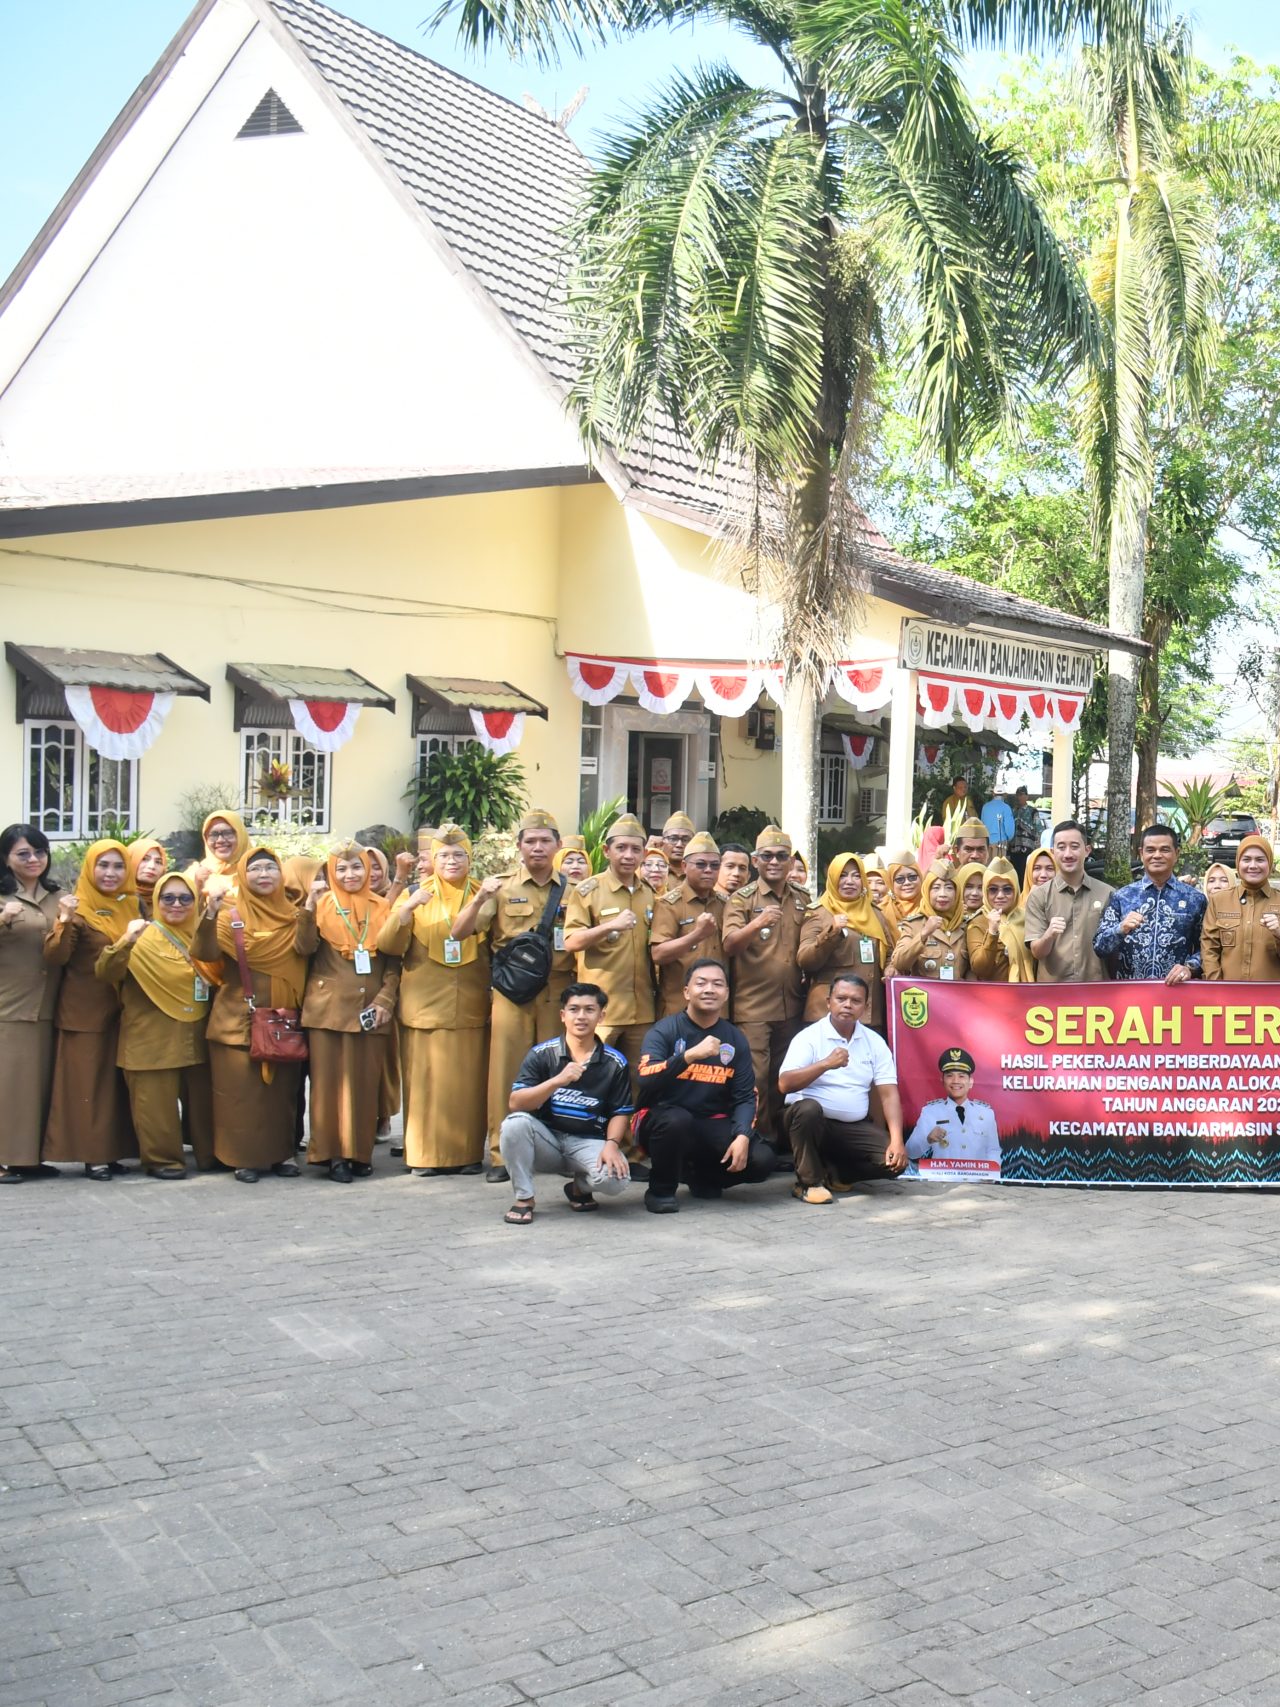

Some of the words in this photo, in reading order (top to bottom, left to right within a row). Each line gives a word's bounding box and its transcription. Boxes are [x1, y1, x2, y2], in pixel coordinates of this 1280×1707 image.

[926, 631, 988, 673] KECAMATAN
[989, 642, 1054, 683] BANJARMASIN
[1055, 654, 1092, 688] SELATAN
[1025, 1006, 1182, 1045] SERAH
[1001, 1054, 1048, 1069] HASIL
[1052, 1054, 1150, 1069] PEKERJAAN
[1002, 1075, 1102, 1090] KELURAHAN
[1105, 1075, 1173, 1090] DENGAN
[1176, 1075, 1223, 1090] DANA
[1102, 1097, 1158, 1112] TAHUN
[1161, 1097, 1253, 1112] ANGGARAN
[1049, 1121, 1149, 1136] KECAMATAN
[1153, 1121, 1272, 1137] BANJARMASIN
[930, 1160, 948, 1168] H.M.
